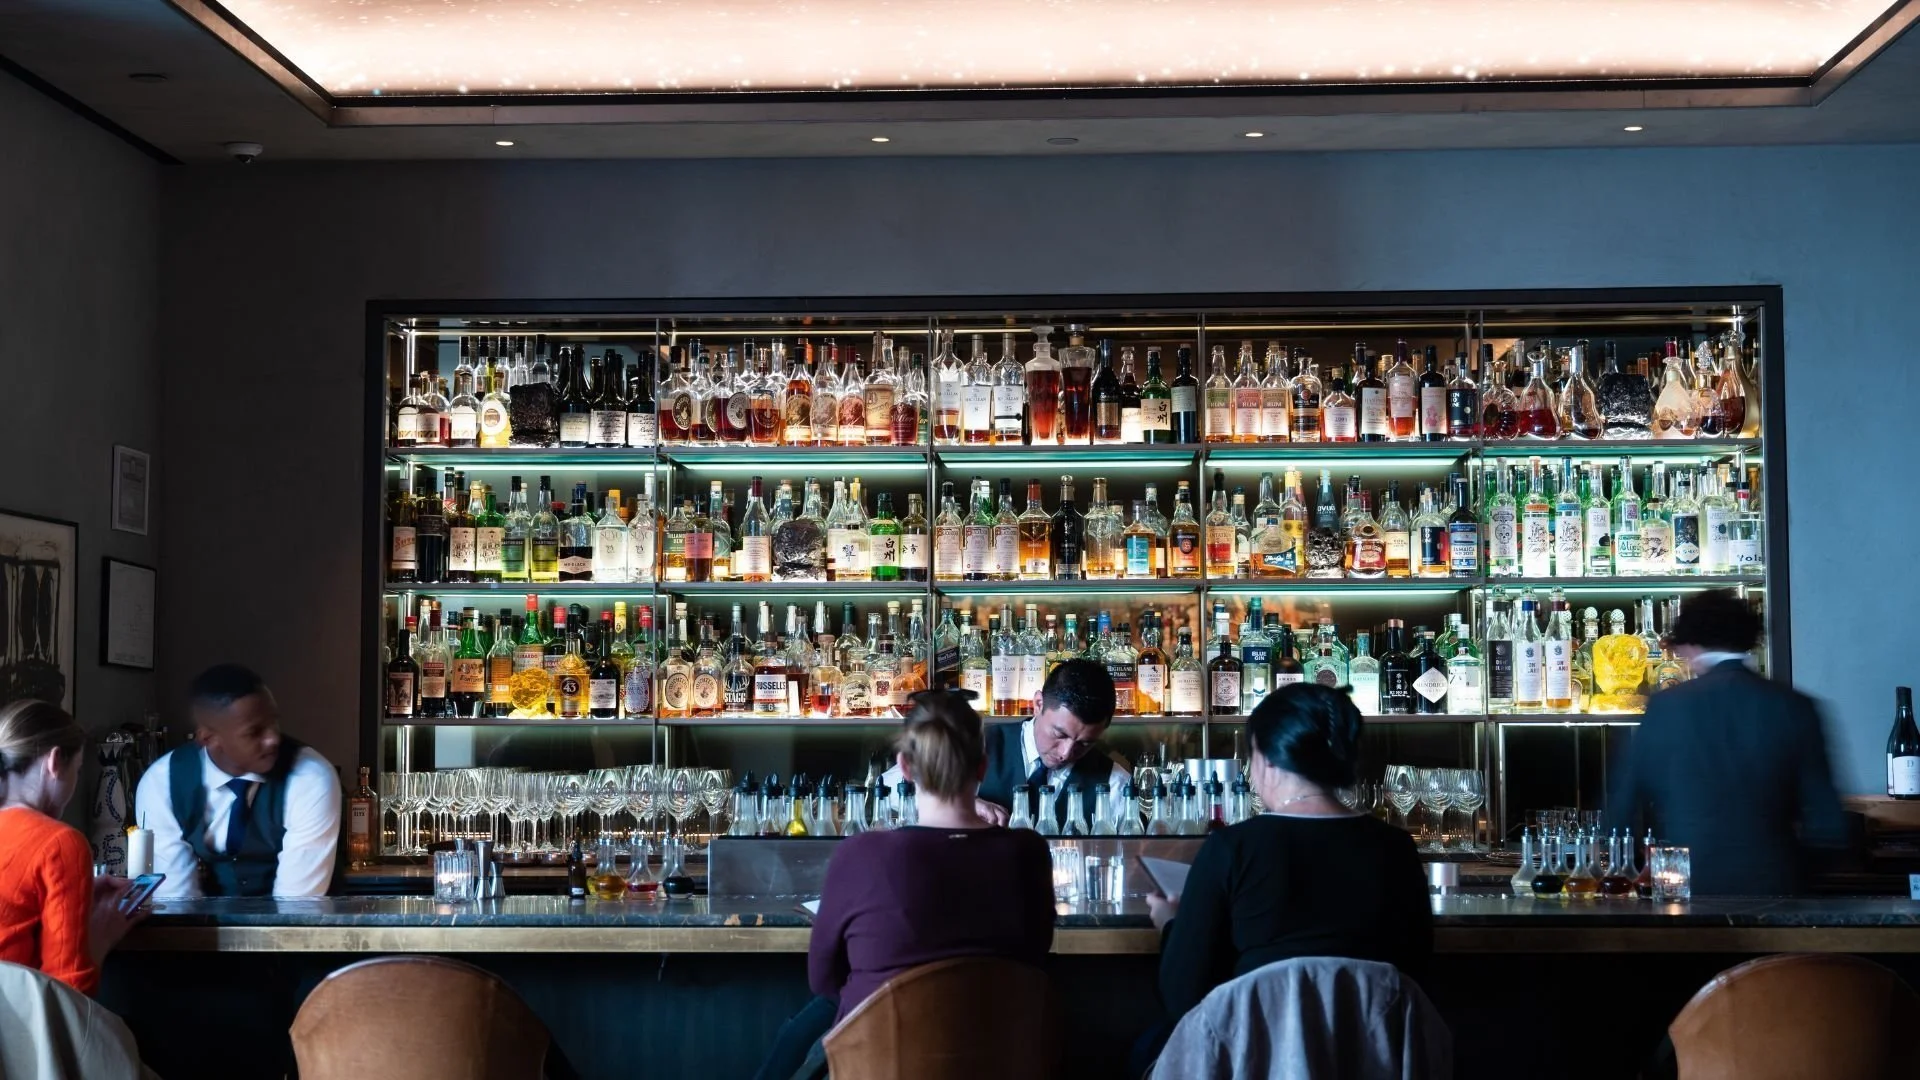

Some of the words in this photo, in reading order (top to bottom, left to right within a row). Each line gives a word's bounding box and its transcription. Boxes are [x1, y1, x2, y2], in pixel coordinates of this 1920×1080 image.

[884, 538, 896, 562] 白州
[563, 683, 577, 693] 43
[756, 681, 786, 690] RUSSELL'S
[724, 692, 746, 703] STAGG
